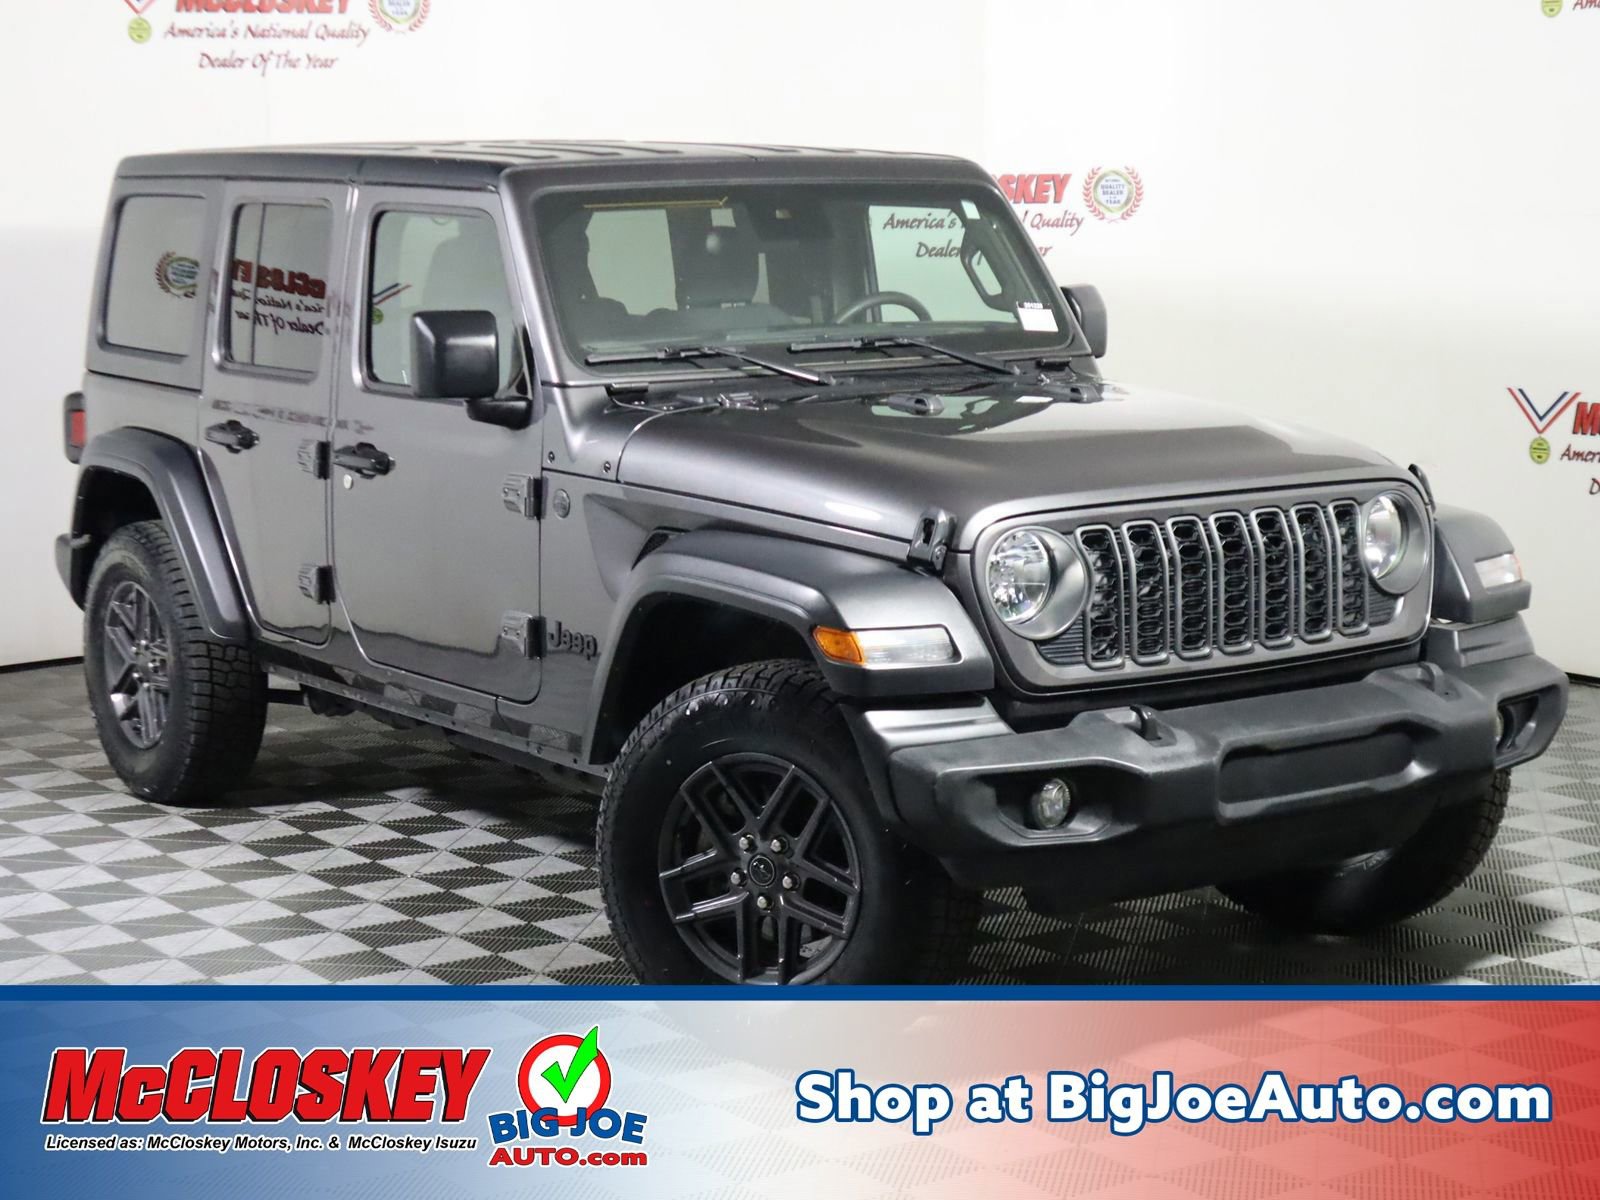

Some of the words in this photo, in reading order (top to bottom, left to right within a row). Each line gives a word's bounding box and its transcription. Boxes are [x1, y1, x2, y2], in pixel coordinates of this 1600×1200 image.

[164, 21, 239, 40] America's
[245, 20, 311, 40] National
[315, 21, 370, 47] Quality
[198, 51, 249, 69] Dealer
[251, 51, 273, 77] Of
[274, 51, 301, 69] The
[304, 52, 339, 69] Year
[992, 173, 1073, 204] SKEY
[883, 211, 957, 230] America's
[1030, 210, 1085, 237] Quality
[547, 620, 598, 661] Jeep
